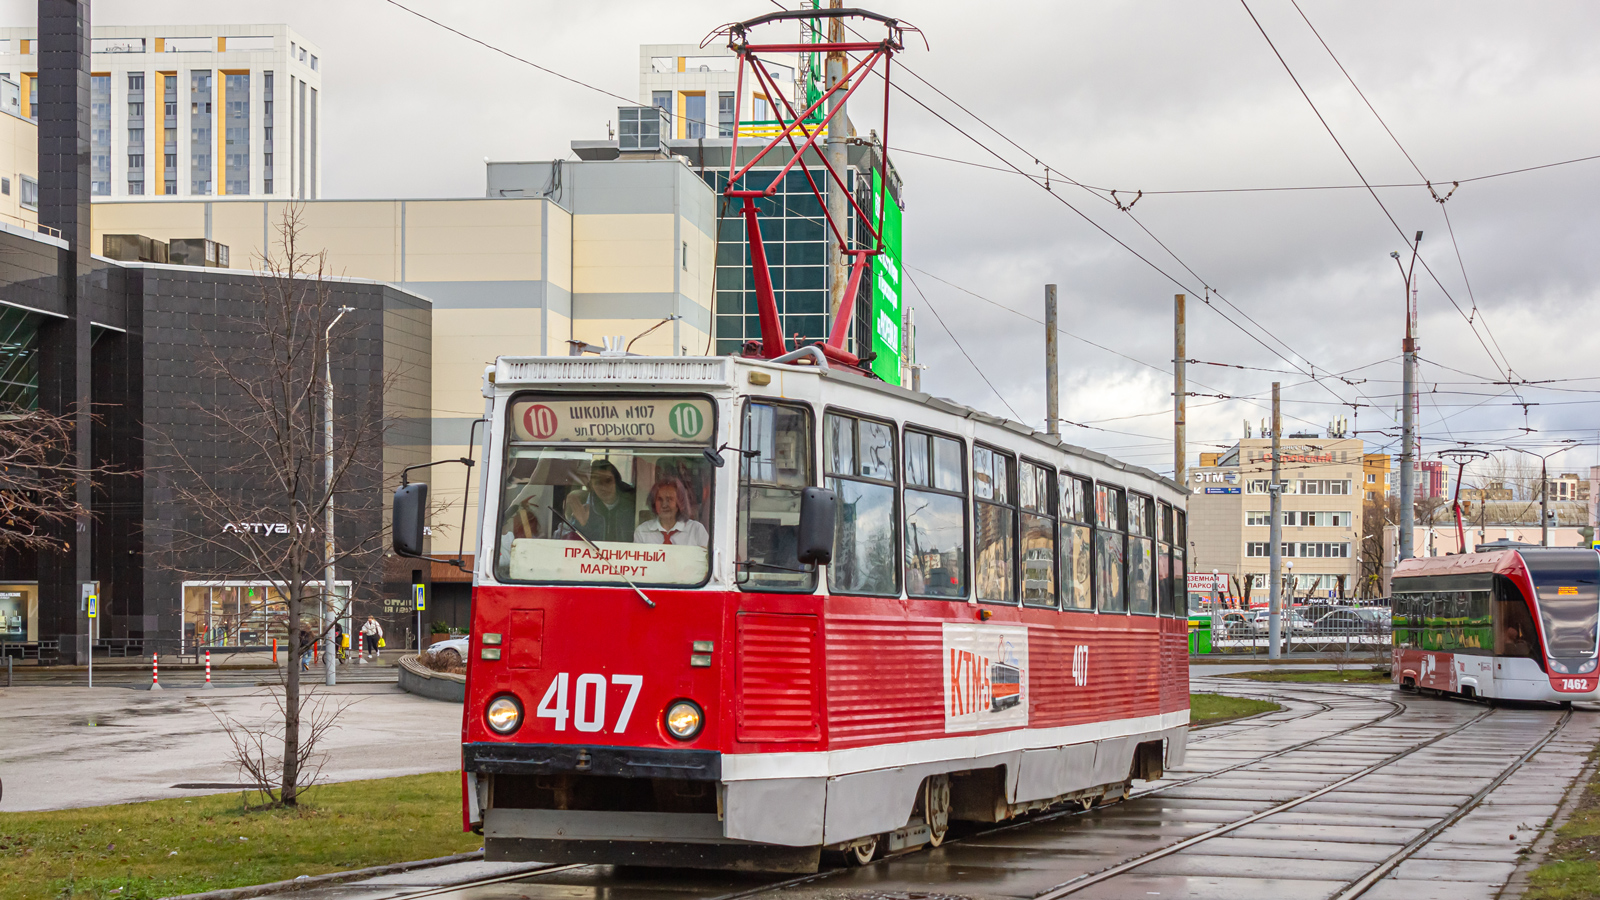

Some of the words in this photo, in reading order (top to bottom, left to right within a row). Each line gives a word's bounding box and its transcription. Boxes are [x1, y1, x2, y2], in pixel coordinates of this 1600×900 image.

[570, 406, 619, 419] ШКОЛА
[529, 408, 553, 437] 10
[674, 406, 698, 436] 10
[1263, 452, 1333, 465] Отровский
[1194, 472, 1224, 483] ЭТМ
[564, 546, 666, 562] ПРАЗДНИЧНЫЙ
[580, 563, 648, 577] МАРШРУТ
[1186, 575, 1220, 583] ДЗЕМНАЯ
[1072, 645, 1089, 687] 407
[950, 648, 990, 717] КТМ-5
[1562, 678, 1588, 690] 7462
[536, 672, 644, 734] 407
